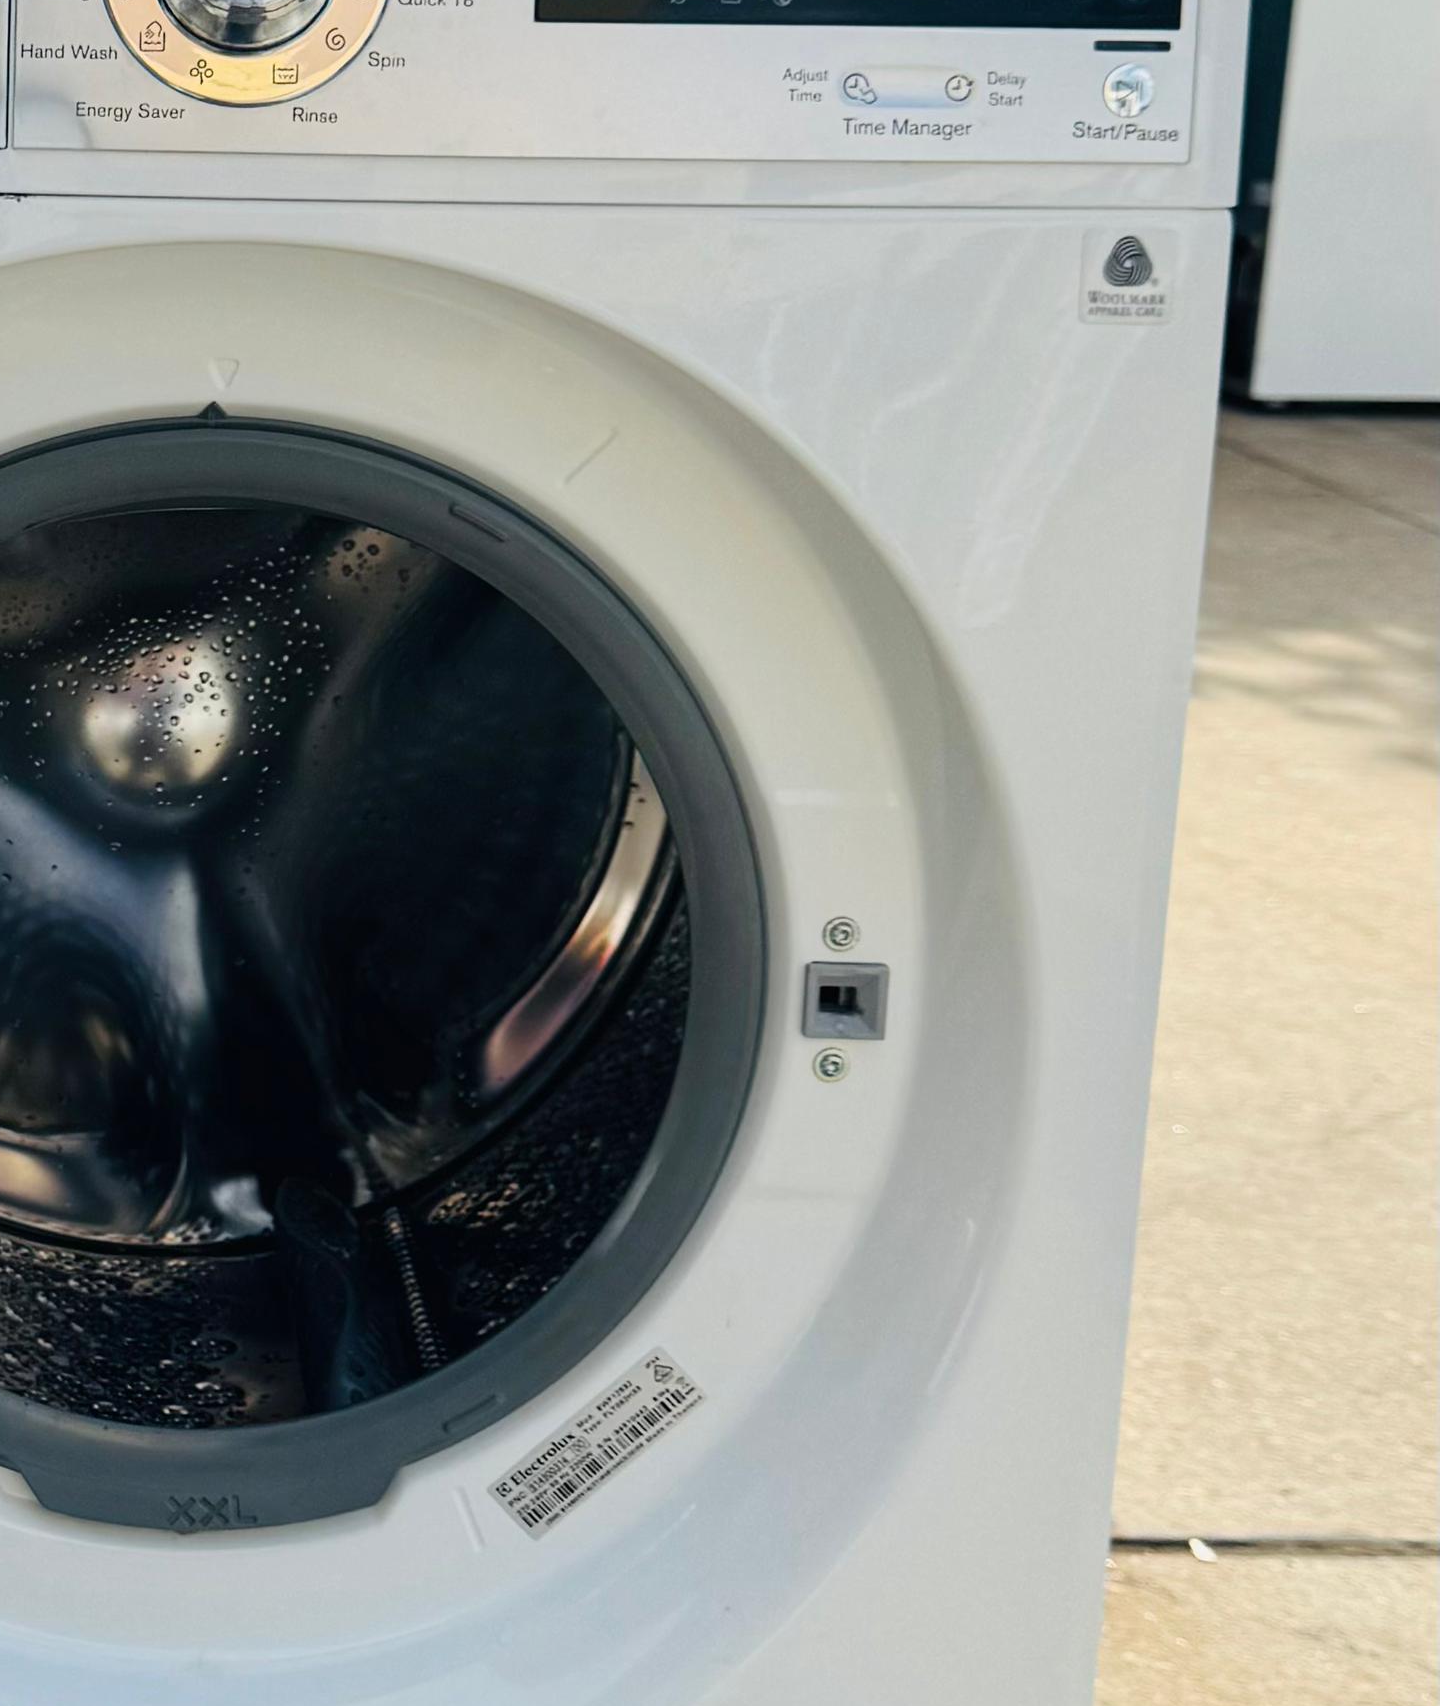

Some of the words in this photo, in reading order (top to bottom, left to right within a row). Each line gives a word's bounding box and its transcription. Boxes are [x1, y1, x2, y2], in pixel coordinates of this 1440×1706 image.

[21, 44, 66, 59] Hand
[71, 45, 119, 61] Wash
[368, 52, 407, 70] Spin
[783, 67, 829, 86] Adjust
[987, 70, 1027, 90] Delay
[788, 88, 822, 103] Time
[988, 91, 1023, 107] Start
[75, 102, 132, 122] Energy
[138, 103, 187, 120] Saver
[292, 107, 338, 125] Rinse
[843, 118, 886, 137] Time
[891, 119, 973, 141] Manager
[1072, 121, 1179, 143] Start/Pause
[510, 1433, 577, 1487] Electrolux
[165, 1496, 258, 1529] XXL
